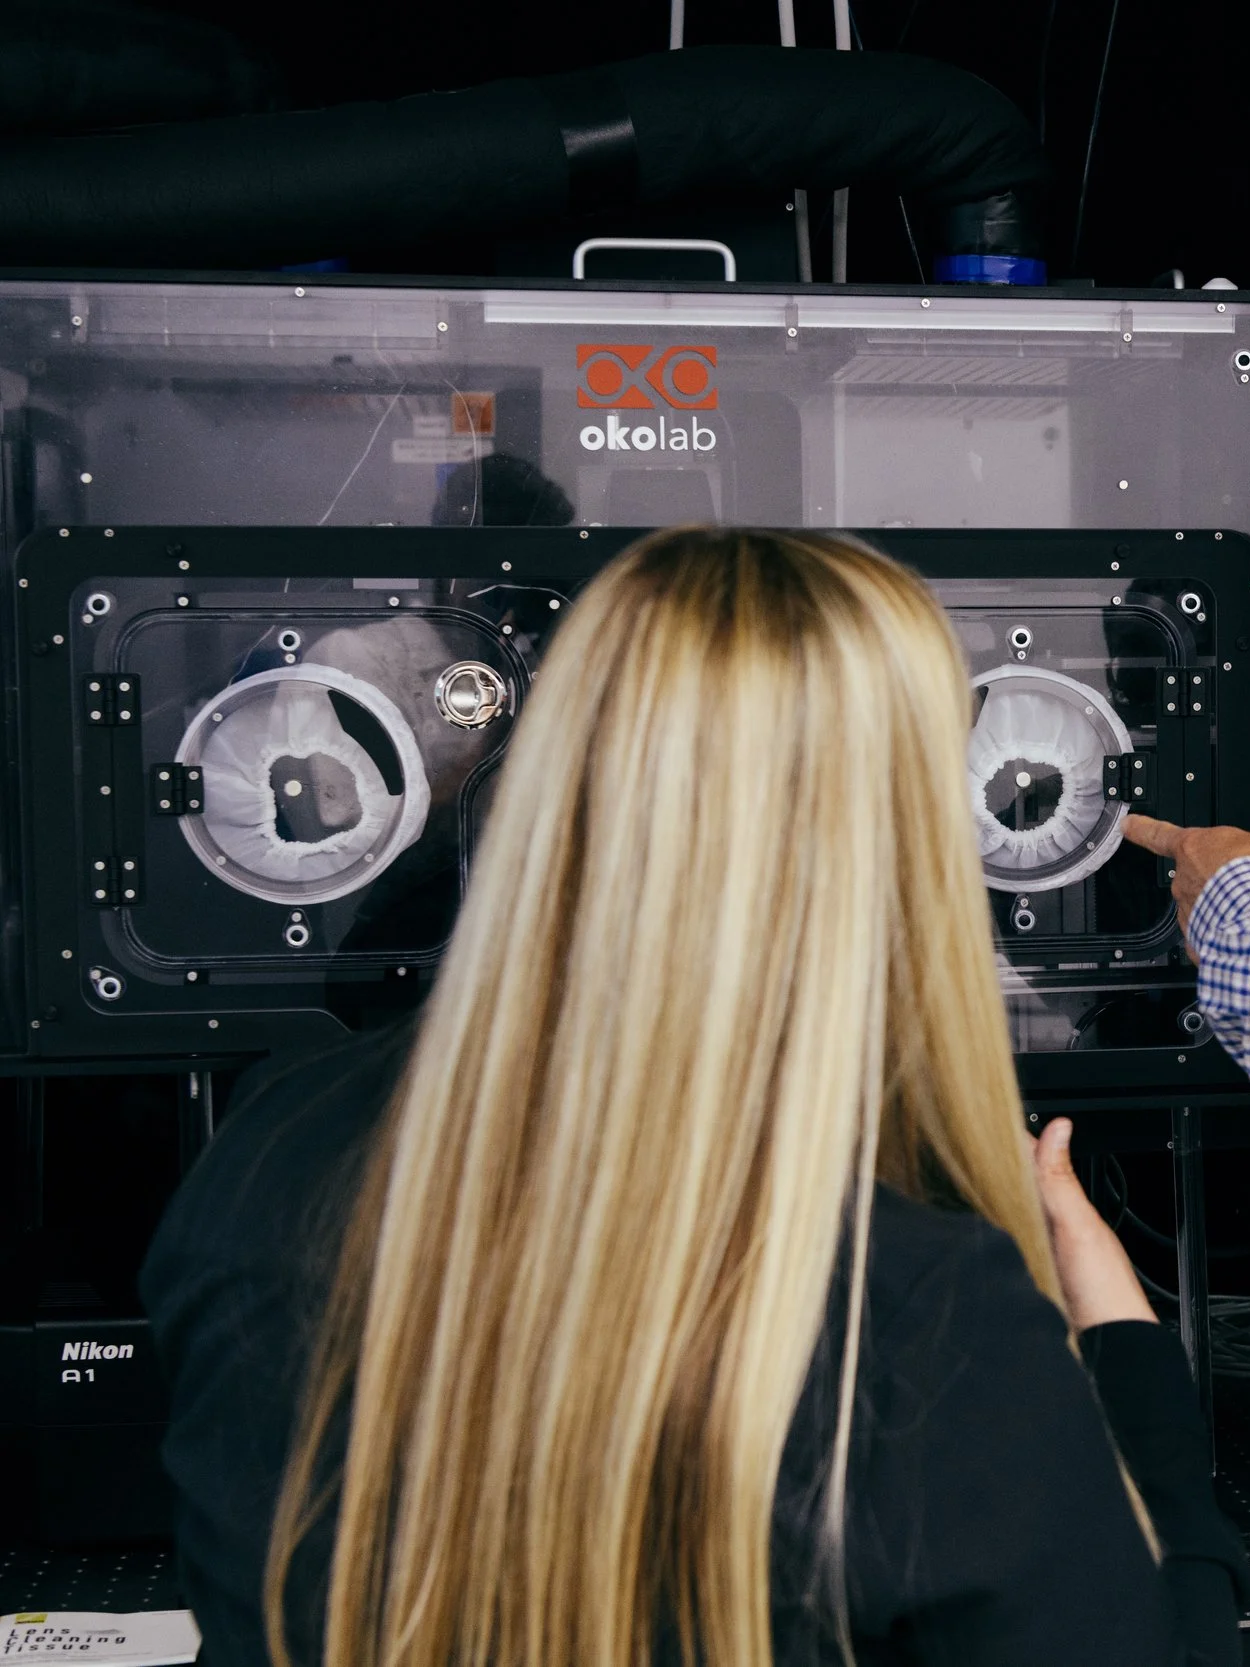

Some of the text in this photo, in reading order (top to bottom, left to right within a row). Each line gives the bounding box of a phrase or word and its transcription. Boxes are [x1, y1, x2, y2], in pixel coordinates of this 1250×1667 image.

[579, 415, 717, 451] okolab
[61, 1341, 134, 1361] Nikon
[62, 1368, 95, 1383] A1
[10, 1628, 71, 1637] Lens
[6, 1635, 127, 1646] Cleaning
[4, 1643, 91, 1654] Tissue
